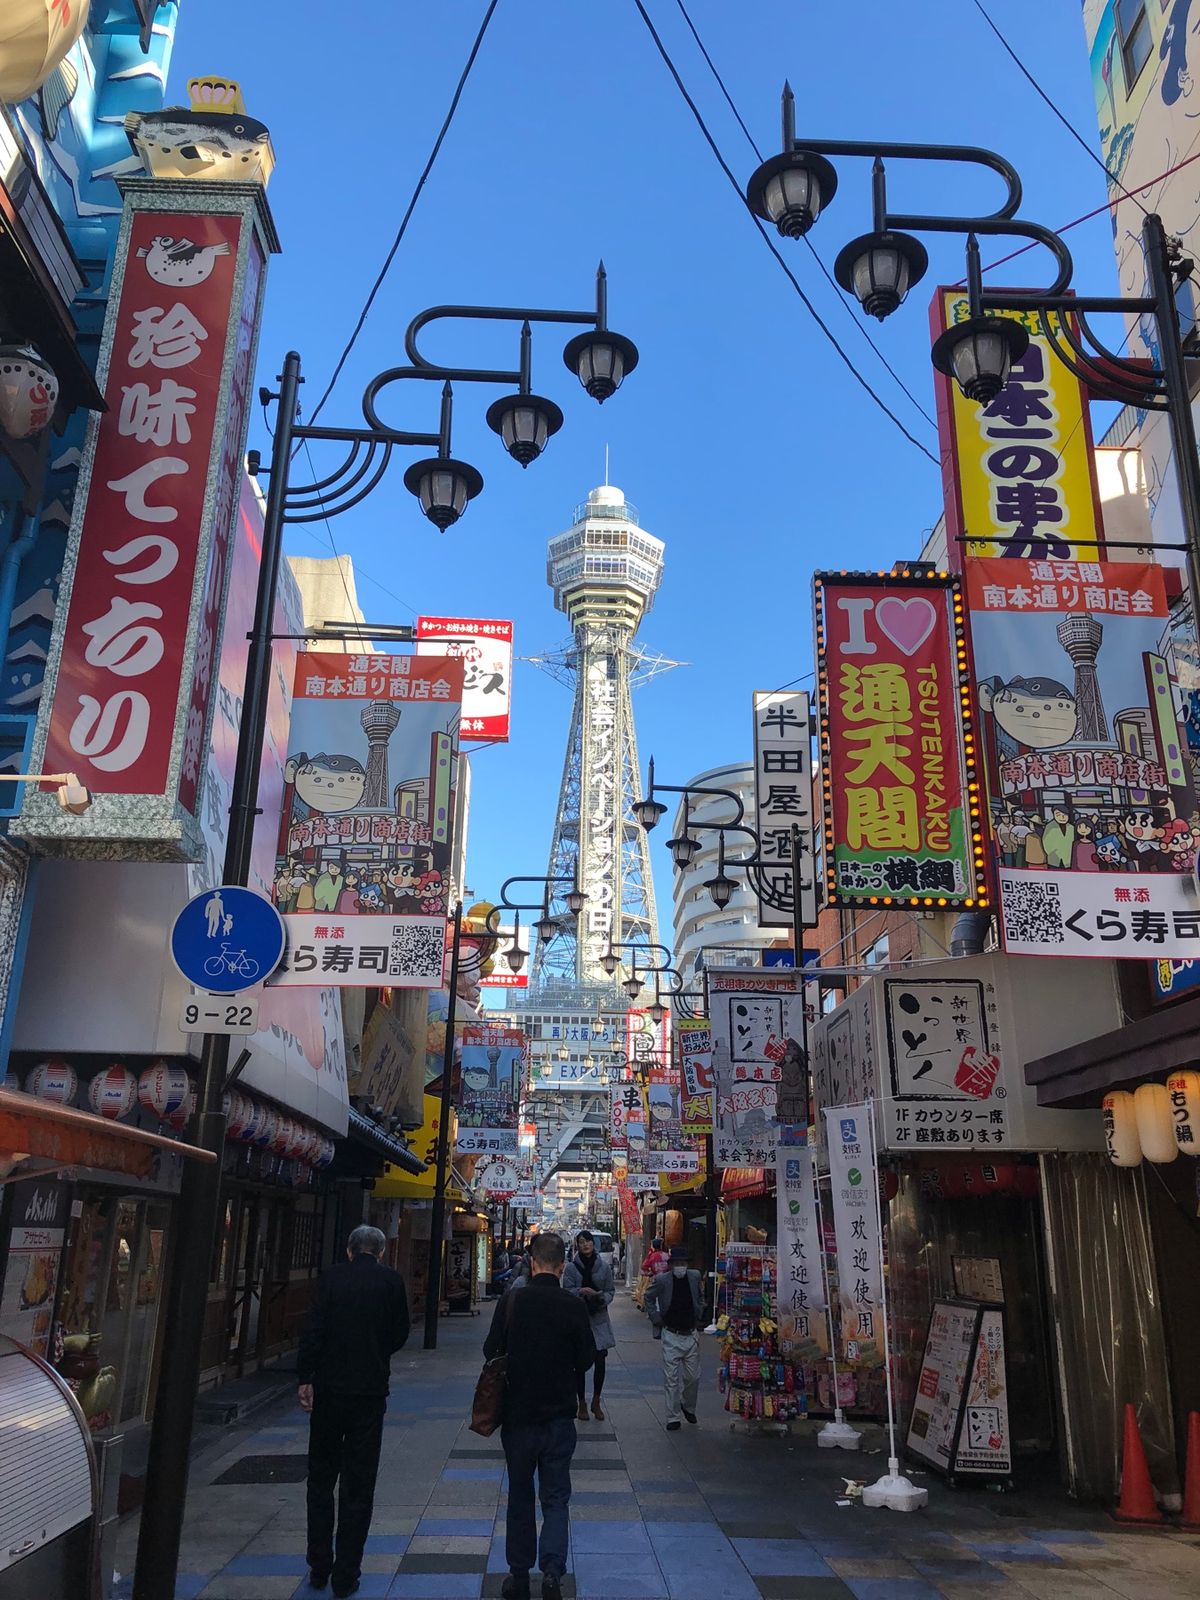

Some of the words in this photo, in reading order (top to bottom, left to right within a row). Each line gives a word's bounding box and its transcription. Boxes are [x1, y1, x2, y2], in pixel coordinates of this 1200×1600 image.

[1029, 561, 1104, 582] 通天閣
[982, 584, 1153, 613] 南本通り商店会
[837, 597, 877, 655] I
[348, 655, 411, 674] 通天閣
[305, 676, 451, 698] 南本通り商店会
[840, 662, 921, 850] 通天閣
[916, 662, 950, 850] TSUTENKAKU
[1003, 752, 1166, 787] 南本通り商店街
[291, 817, 432, 842] 南本通り商店街
[840, 862, 882, 873] 日本一の
[841, 875, 883, 888] 串かつ
[1114, 887, 1150, 903] 無添
[314, 926, 345, 938] 無添
[1065, 908, 1200, 944] くら寿司
[283, 945, 389, 974] ら寿司
[682, 1031, 710, 1043] 新世界
[896, 1108, 909, 1122] 1F
[915, 1108, 1003, 1124] カウンター席
[1170, 1091, 1193, 1143] もつ鍋
[457, 1139, 500, 1150] くら寿司
[896, 1129, 911, 1142] 2F
[916, 1129, 1005, 1143] 座敷あります
[664, 1157, 697, 1169] くら寿司
[25, 1187, 59, 1221] Asahi
[789, 1238, 811, 1338] 欢迎使用
[851, 1215, 874, 1338] 欢迎使用
